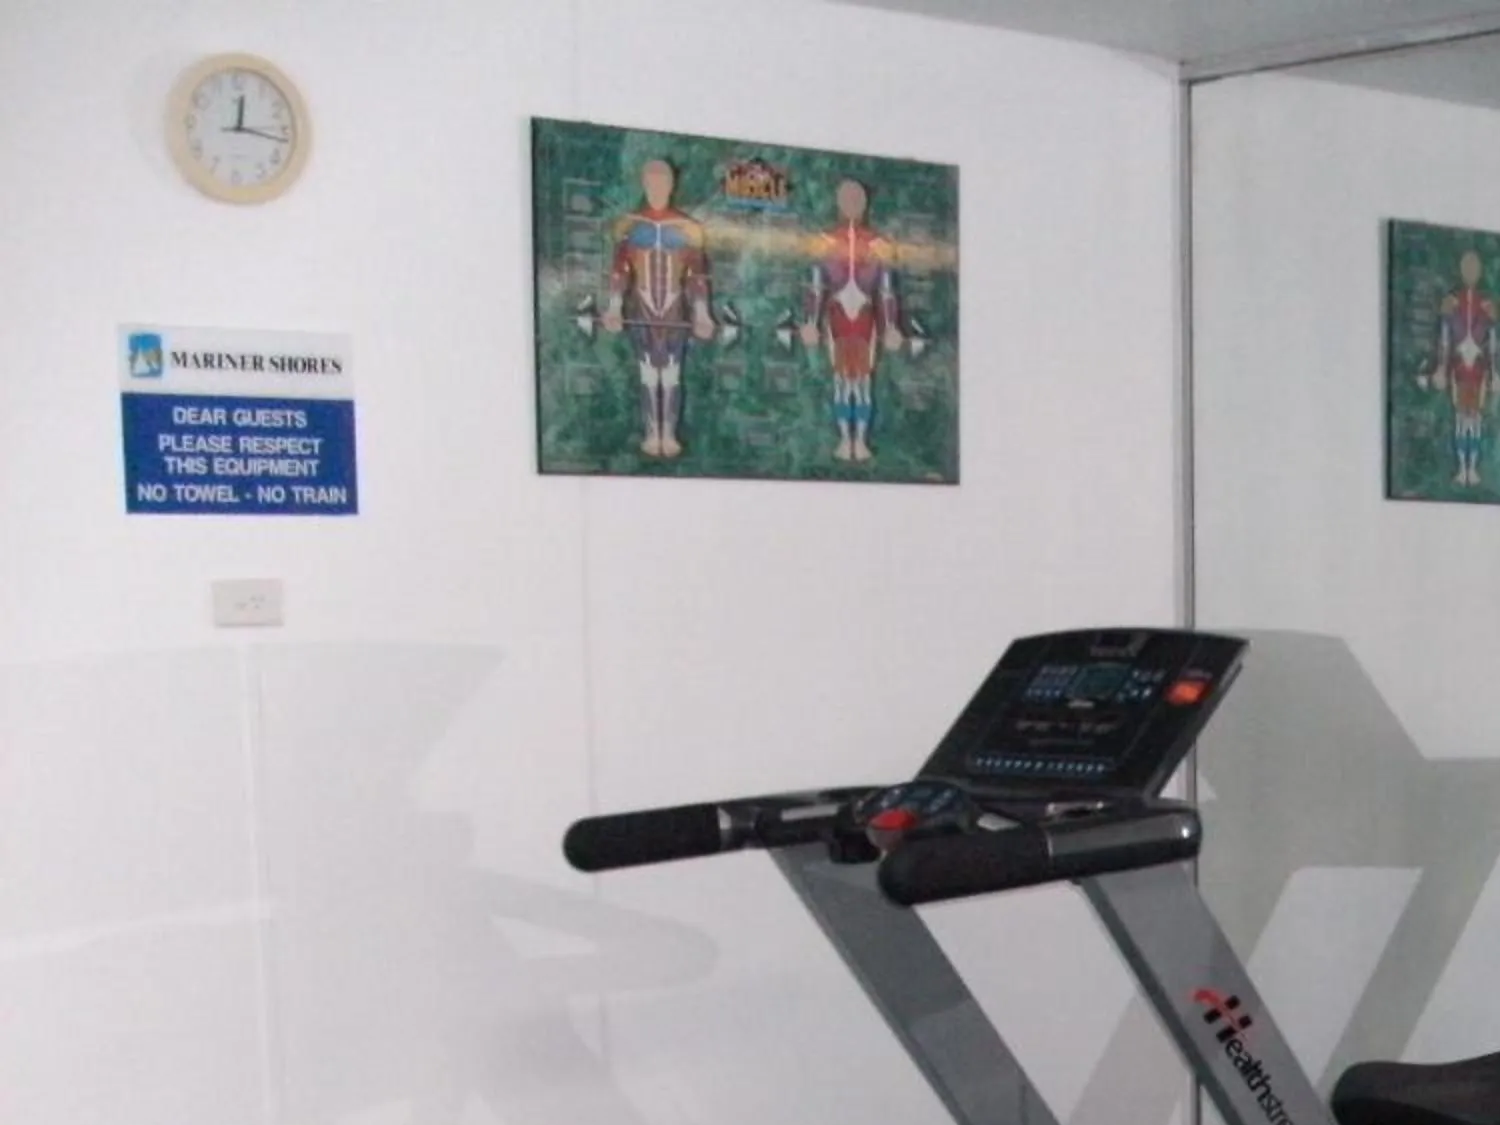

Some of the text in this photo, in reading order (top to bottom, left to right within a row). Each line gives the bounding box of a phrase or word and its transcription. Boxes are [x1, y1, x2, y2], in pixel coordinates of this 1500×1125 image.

[171, 351, 343, 375] MARINER SHORES
[172, 406, 308, 428] DEAR GUESTS
[158, 433, 323, 455] PLEASE RESPECT
[164, 456, 320, 477] THIS EQUIPMENT
[137, 483, 166, 502] NO
[174, 484, 240, 503] TOWEL
[257, 485, 286, 504] NO
[291, 486, 347, 504] TRAIN
